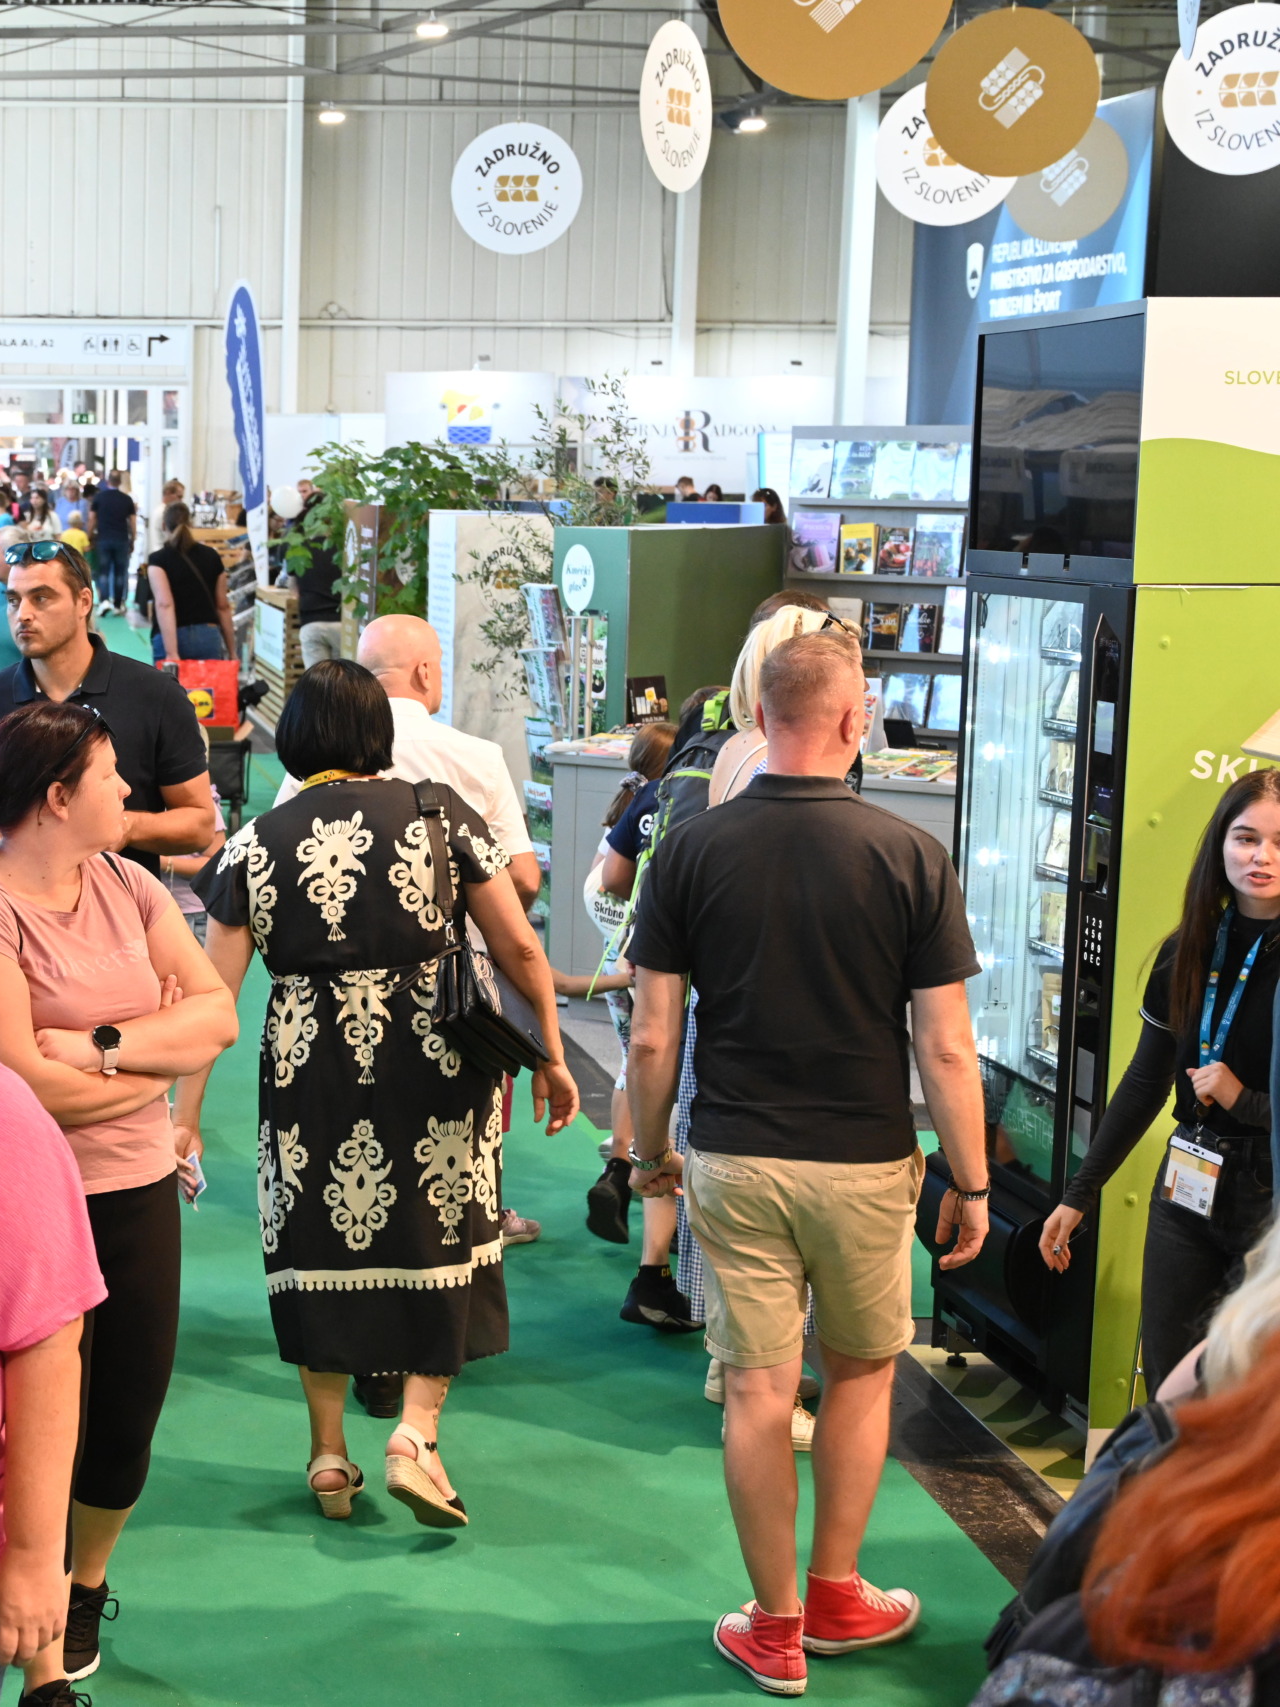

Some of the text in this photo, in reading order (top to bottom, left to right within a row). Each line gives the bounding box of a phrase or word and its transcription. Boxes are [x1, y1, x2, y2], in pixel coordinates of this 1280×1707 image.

[655, 48, 701, 93] ZADRUŽNO
[1195, 28, 1280, 77] ZADRUŽ
[655, 120, 701, 168] IZ SLOVENIJE
[1195, 108, 1280, 151] IZ SLOVEN
[475, 141, 560, 178] ZADRUŽNO
[902, 166, 991, 204] IZ SLOVENIJ
[476, 200, 559, 235] IZ SLOVENIJE
[41, 339, 55, 348] A2
[594, 901, 625, 920] Skrbno
